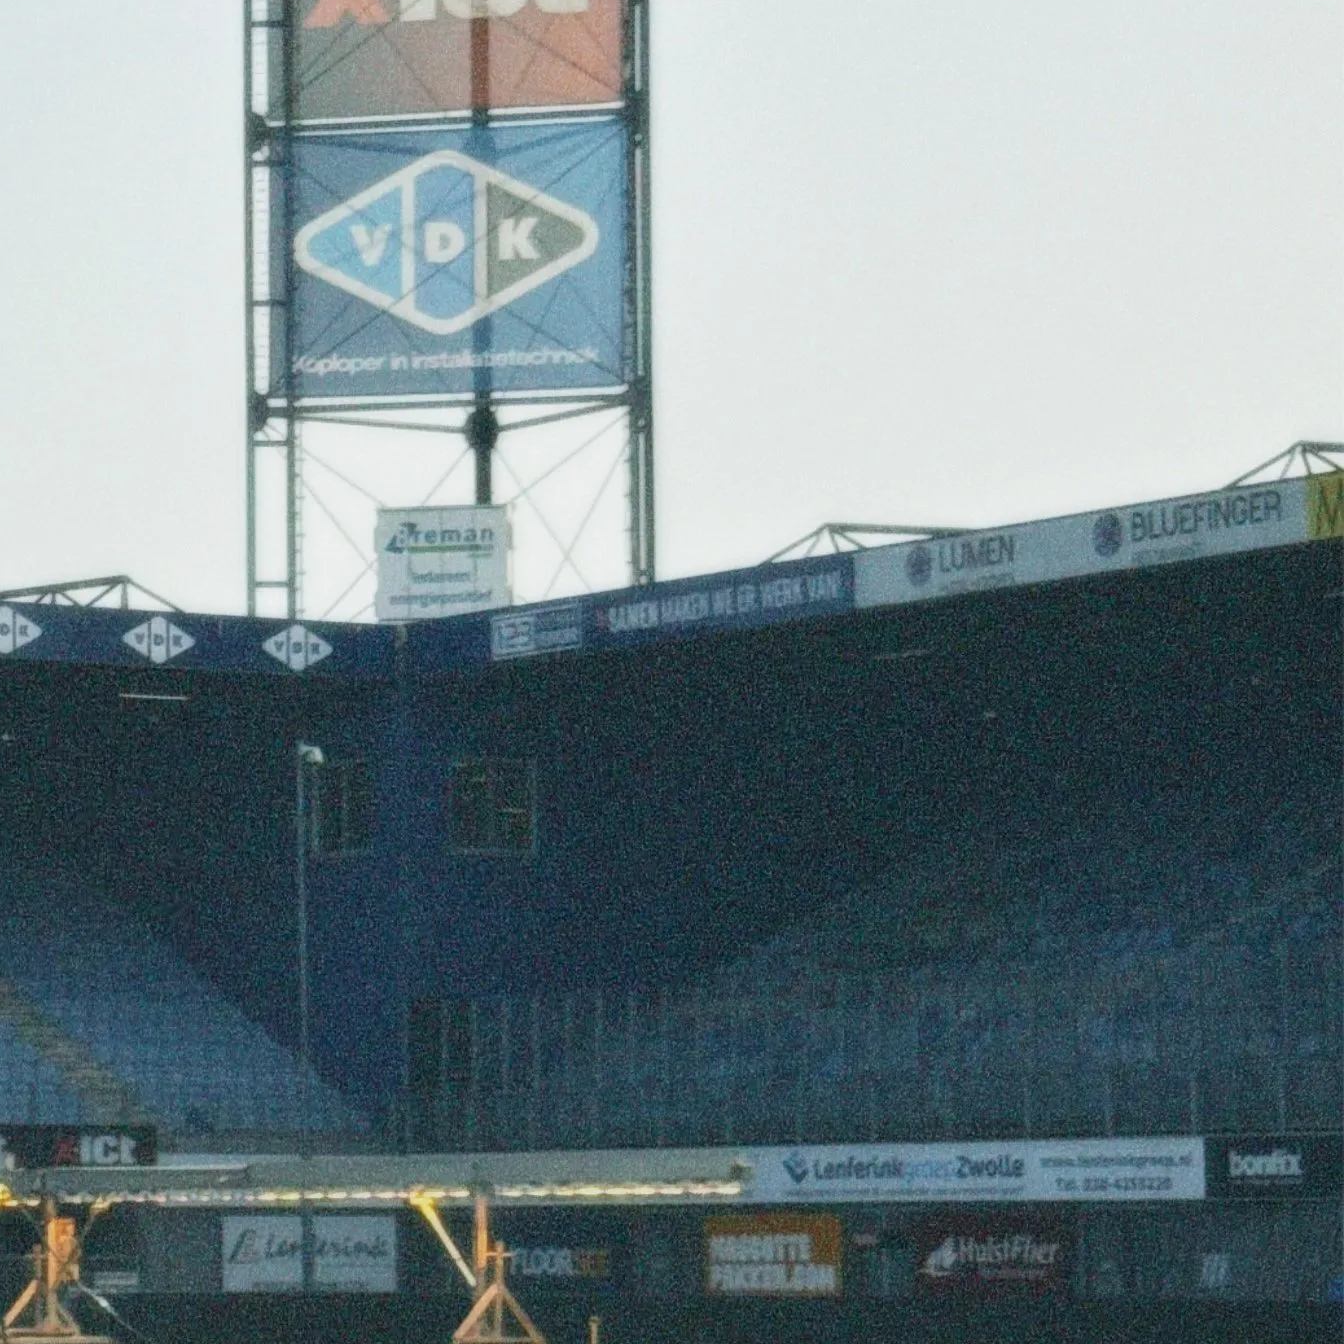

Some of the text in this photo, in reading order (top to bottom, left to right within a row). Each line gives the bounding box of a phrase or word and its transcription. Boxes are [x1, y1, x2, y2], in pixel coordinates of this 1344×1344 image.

[350, 217, 541, 267] VDK
[391, 352, 408, 370] in
[1131, 491, 1282, 542] BLUEFINGER
